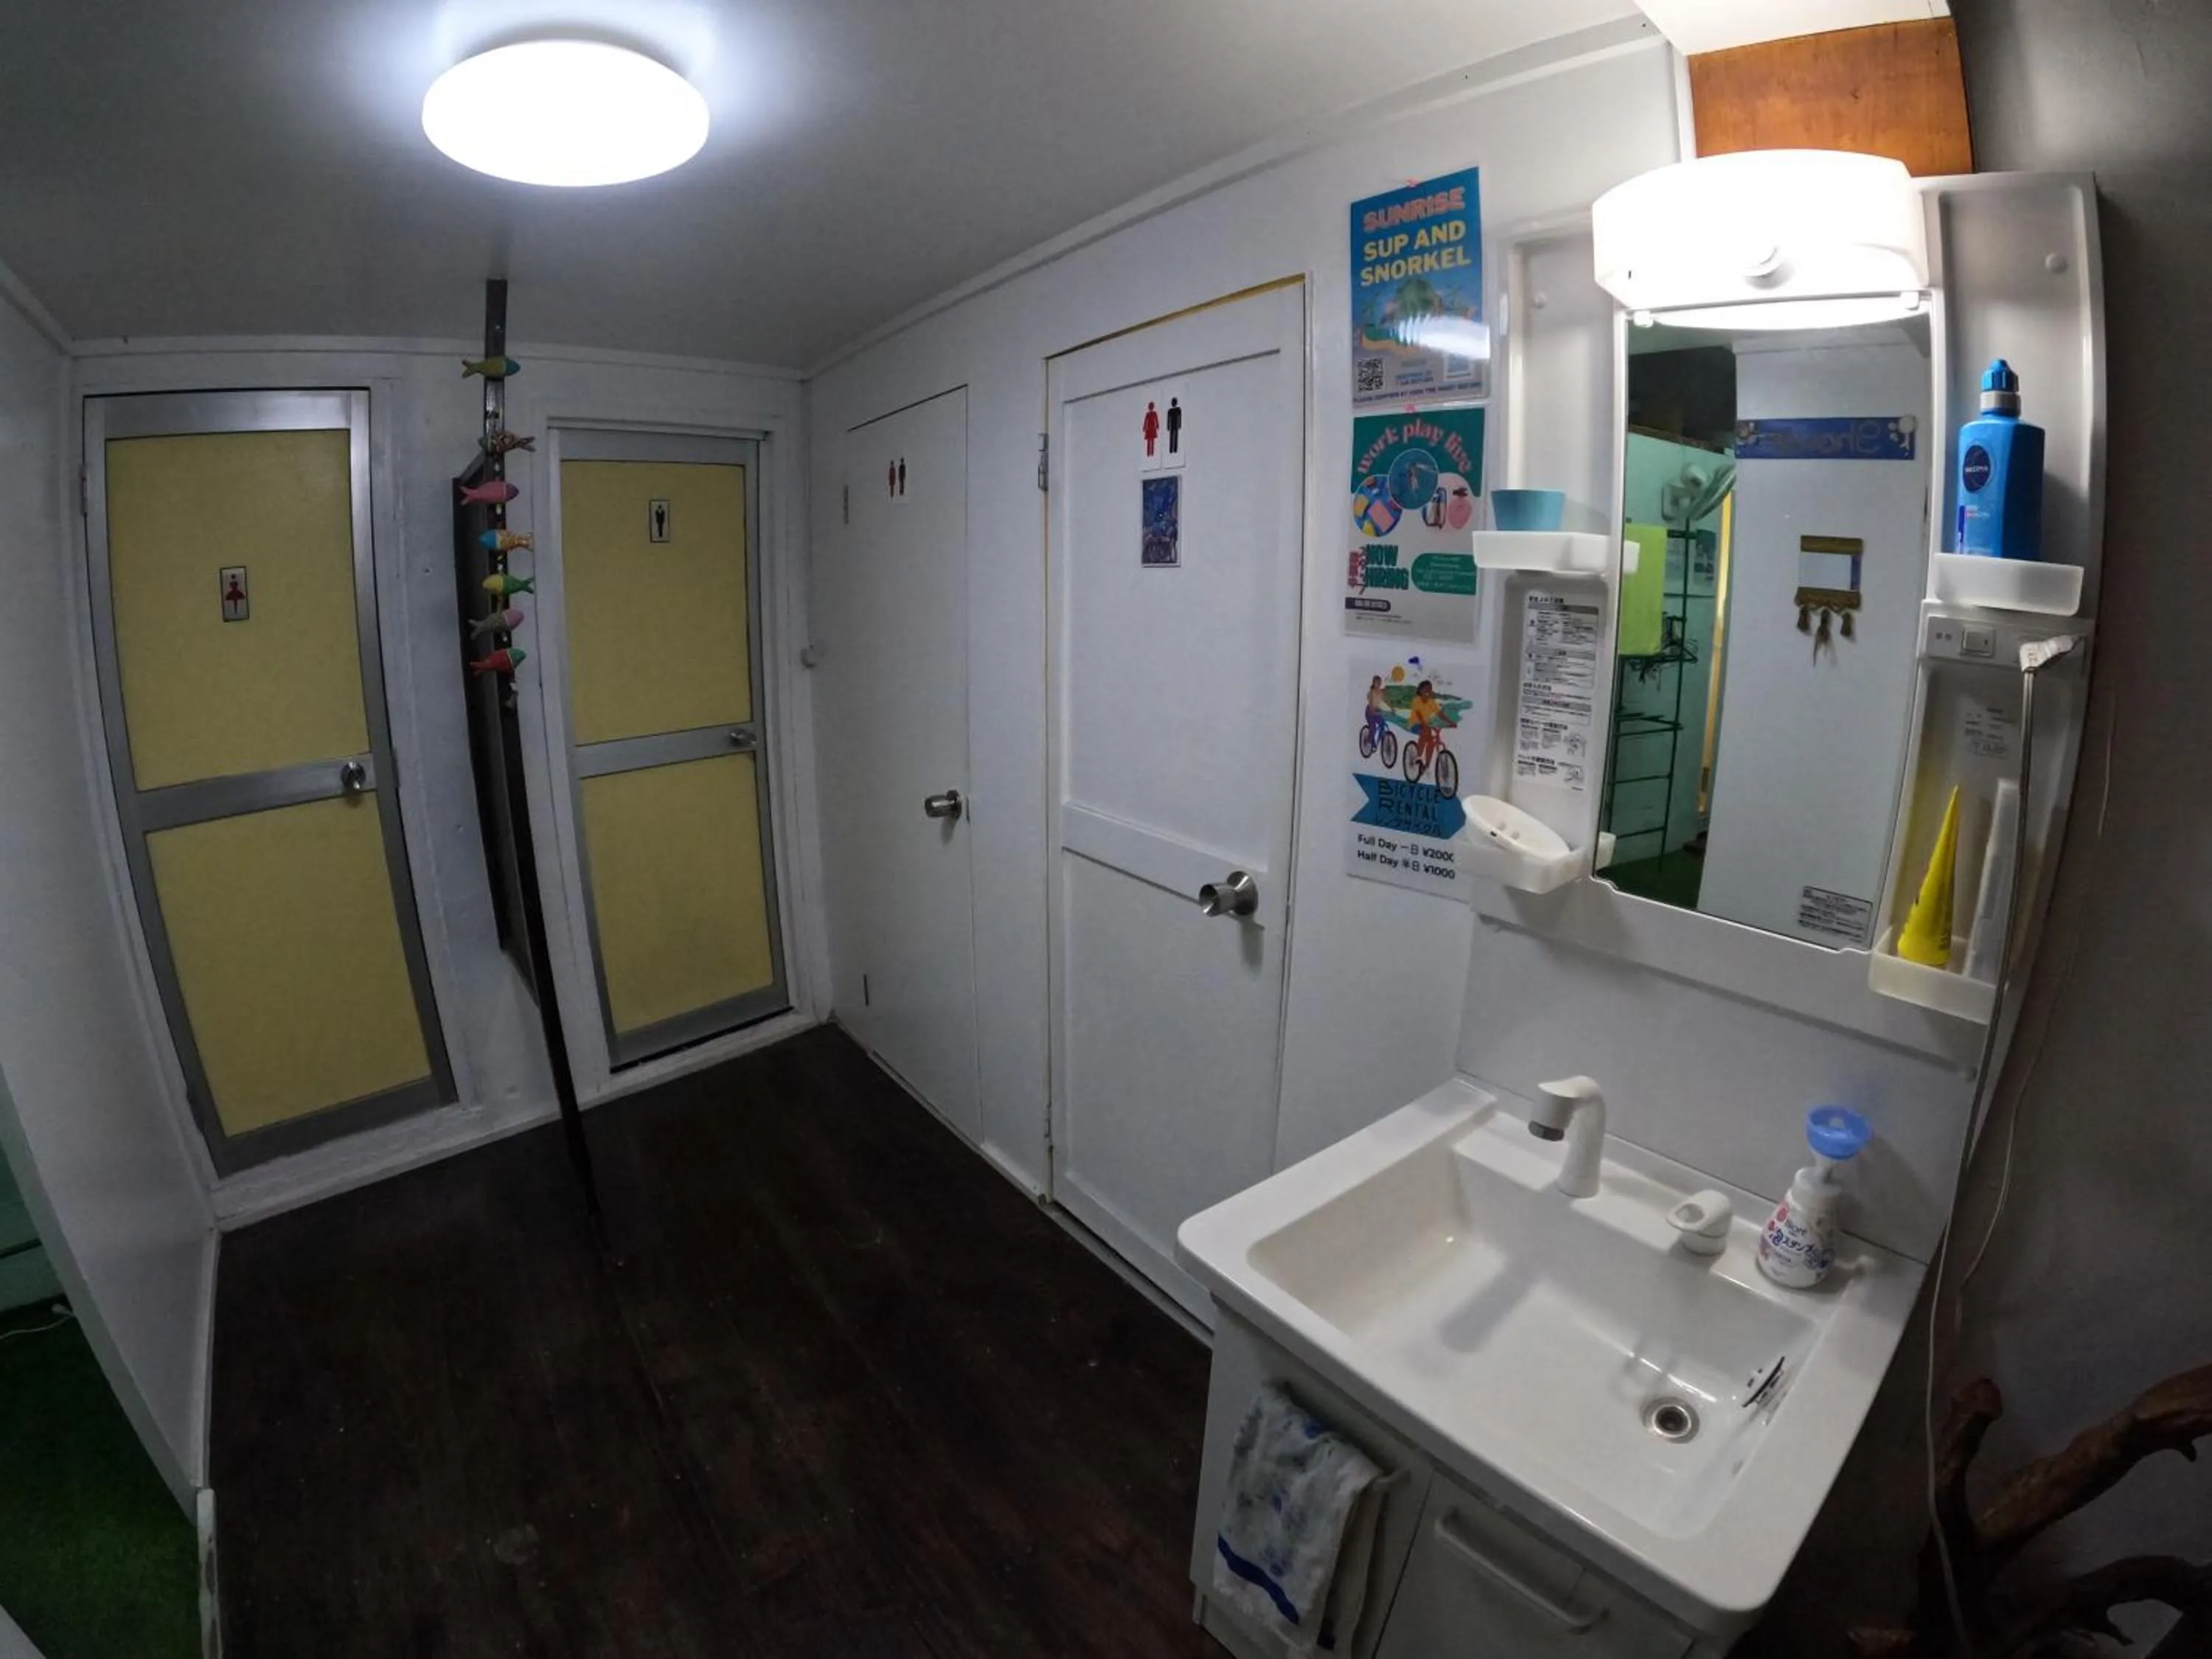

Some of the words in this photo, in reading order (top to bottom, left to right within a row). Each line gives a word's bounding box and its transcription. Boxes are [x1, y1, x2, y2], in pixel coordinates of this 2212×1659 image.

[1364, 187, 1465, 232] SUNRISE
[1364, 234, 1409, 261] SUP
[1414, 220, 1466, 249] AND
[1360, 246, 1472, 287] SNORKEL
[1357, 427, 1398, 474] work
[1403, 418, 1443, 447] play
[1444, 432, 1473, 474] live
[1378, 779, 1441, 804] BICYCLE
[1378, 796, 1439, 821] RENTAL
[1357, 833, 1377, 846] Full
[1378, 838, 1398, 852] Day
[1357, 849, 1377, 863] Half
[1380, 853, 1399, 869] Day
[1422, 863, 1456, 880] ¥1000
